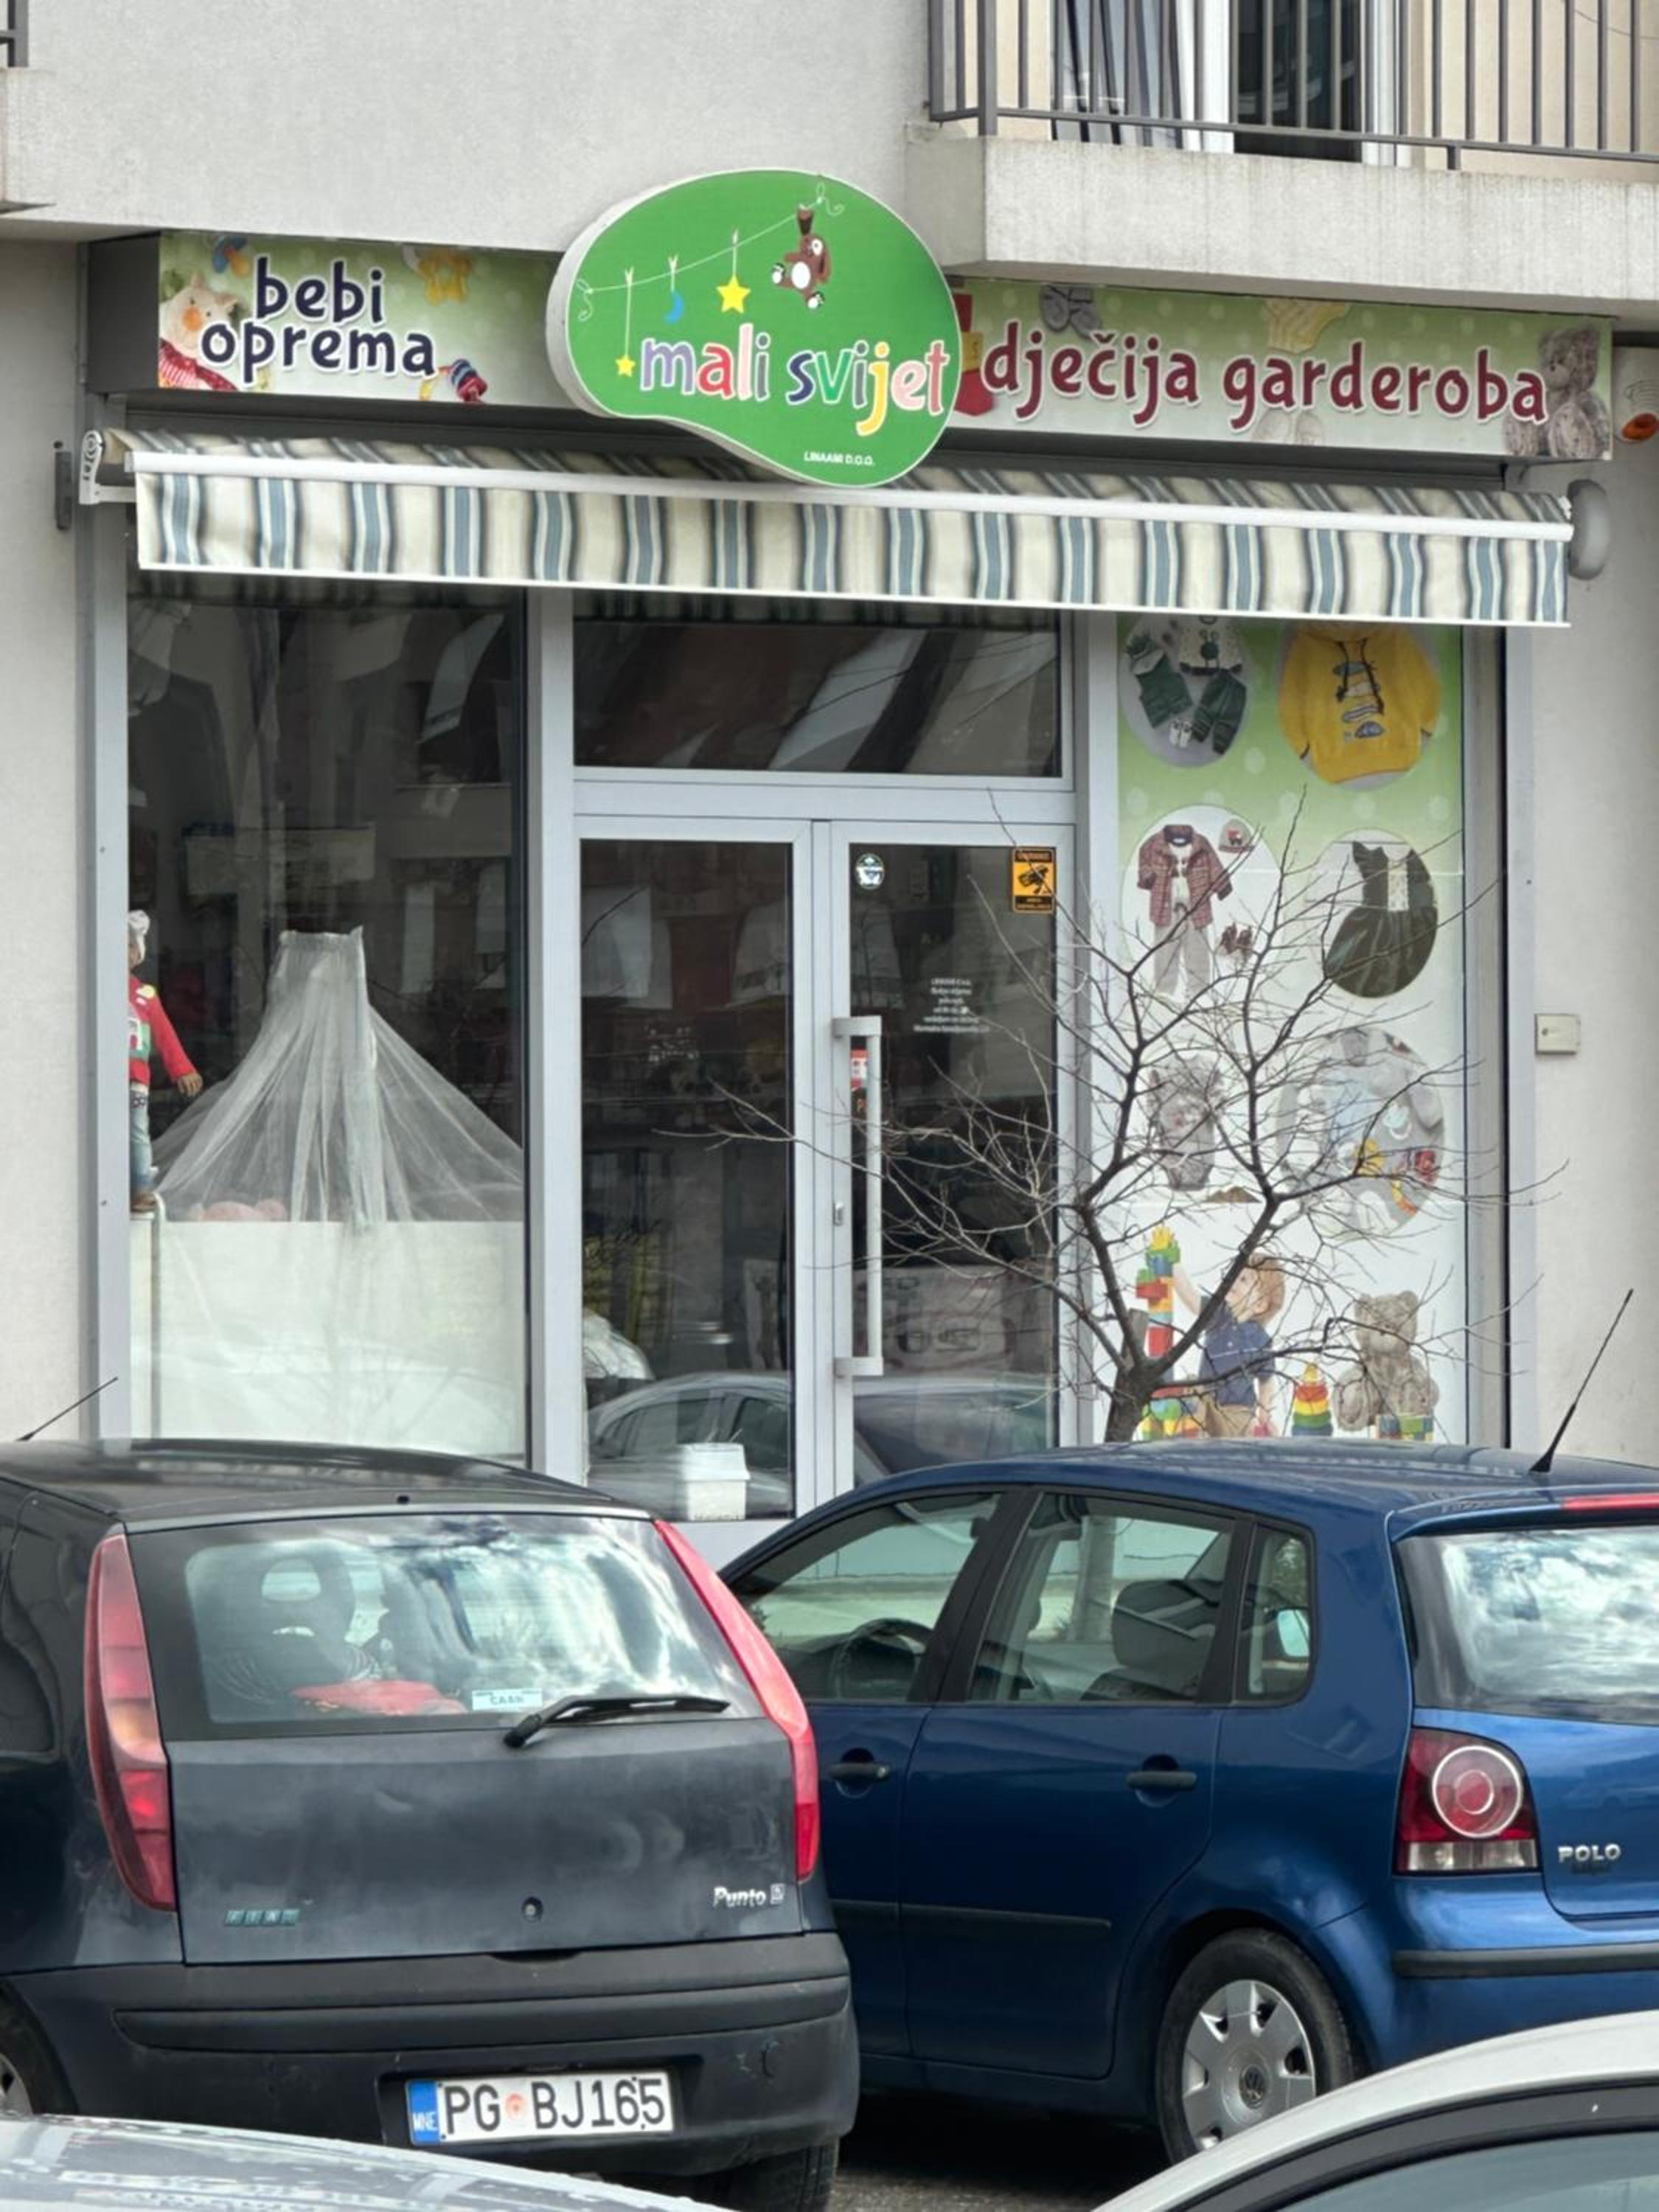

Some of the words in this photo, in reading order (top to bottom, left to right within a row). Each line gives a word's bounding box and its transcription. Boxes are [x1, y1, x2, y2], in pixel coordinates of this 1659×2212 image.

[256, 255, 384, 323] bebi
[201, 320, 435, 383] oprema
[640, 323, 771, 402] mali
[786, 339, 950, 436] svijet
[982, 319, 1200, 426] dječija
[1222, 340, 1548, 430] garderoba
[1557, 1843, 1621, 1863] POLO
[713, 1886, 767, 1908] Punto
[444, 2084, 501, 2135] PG
[530, 2078, 665, 2129] BJ165
